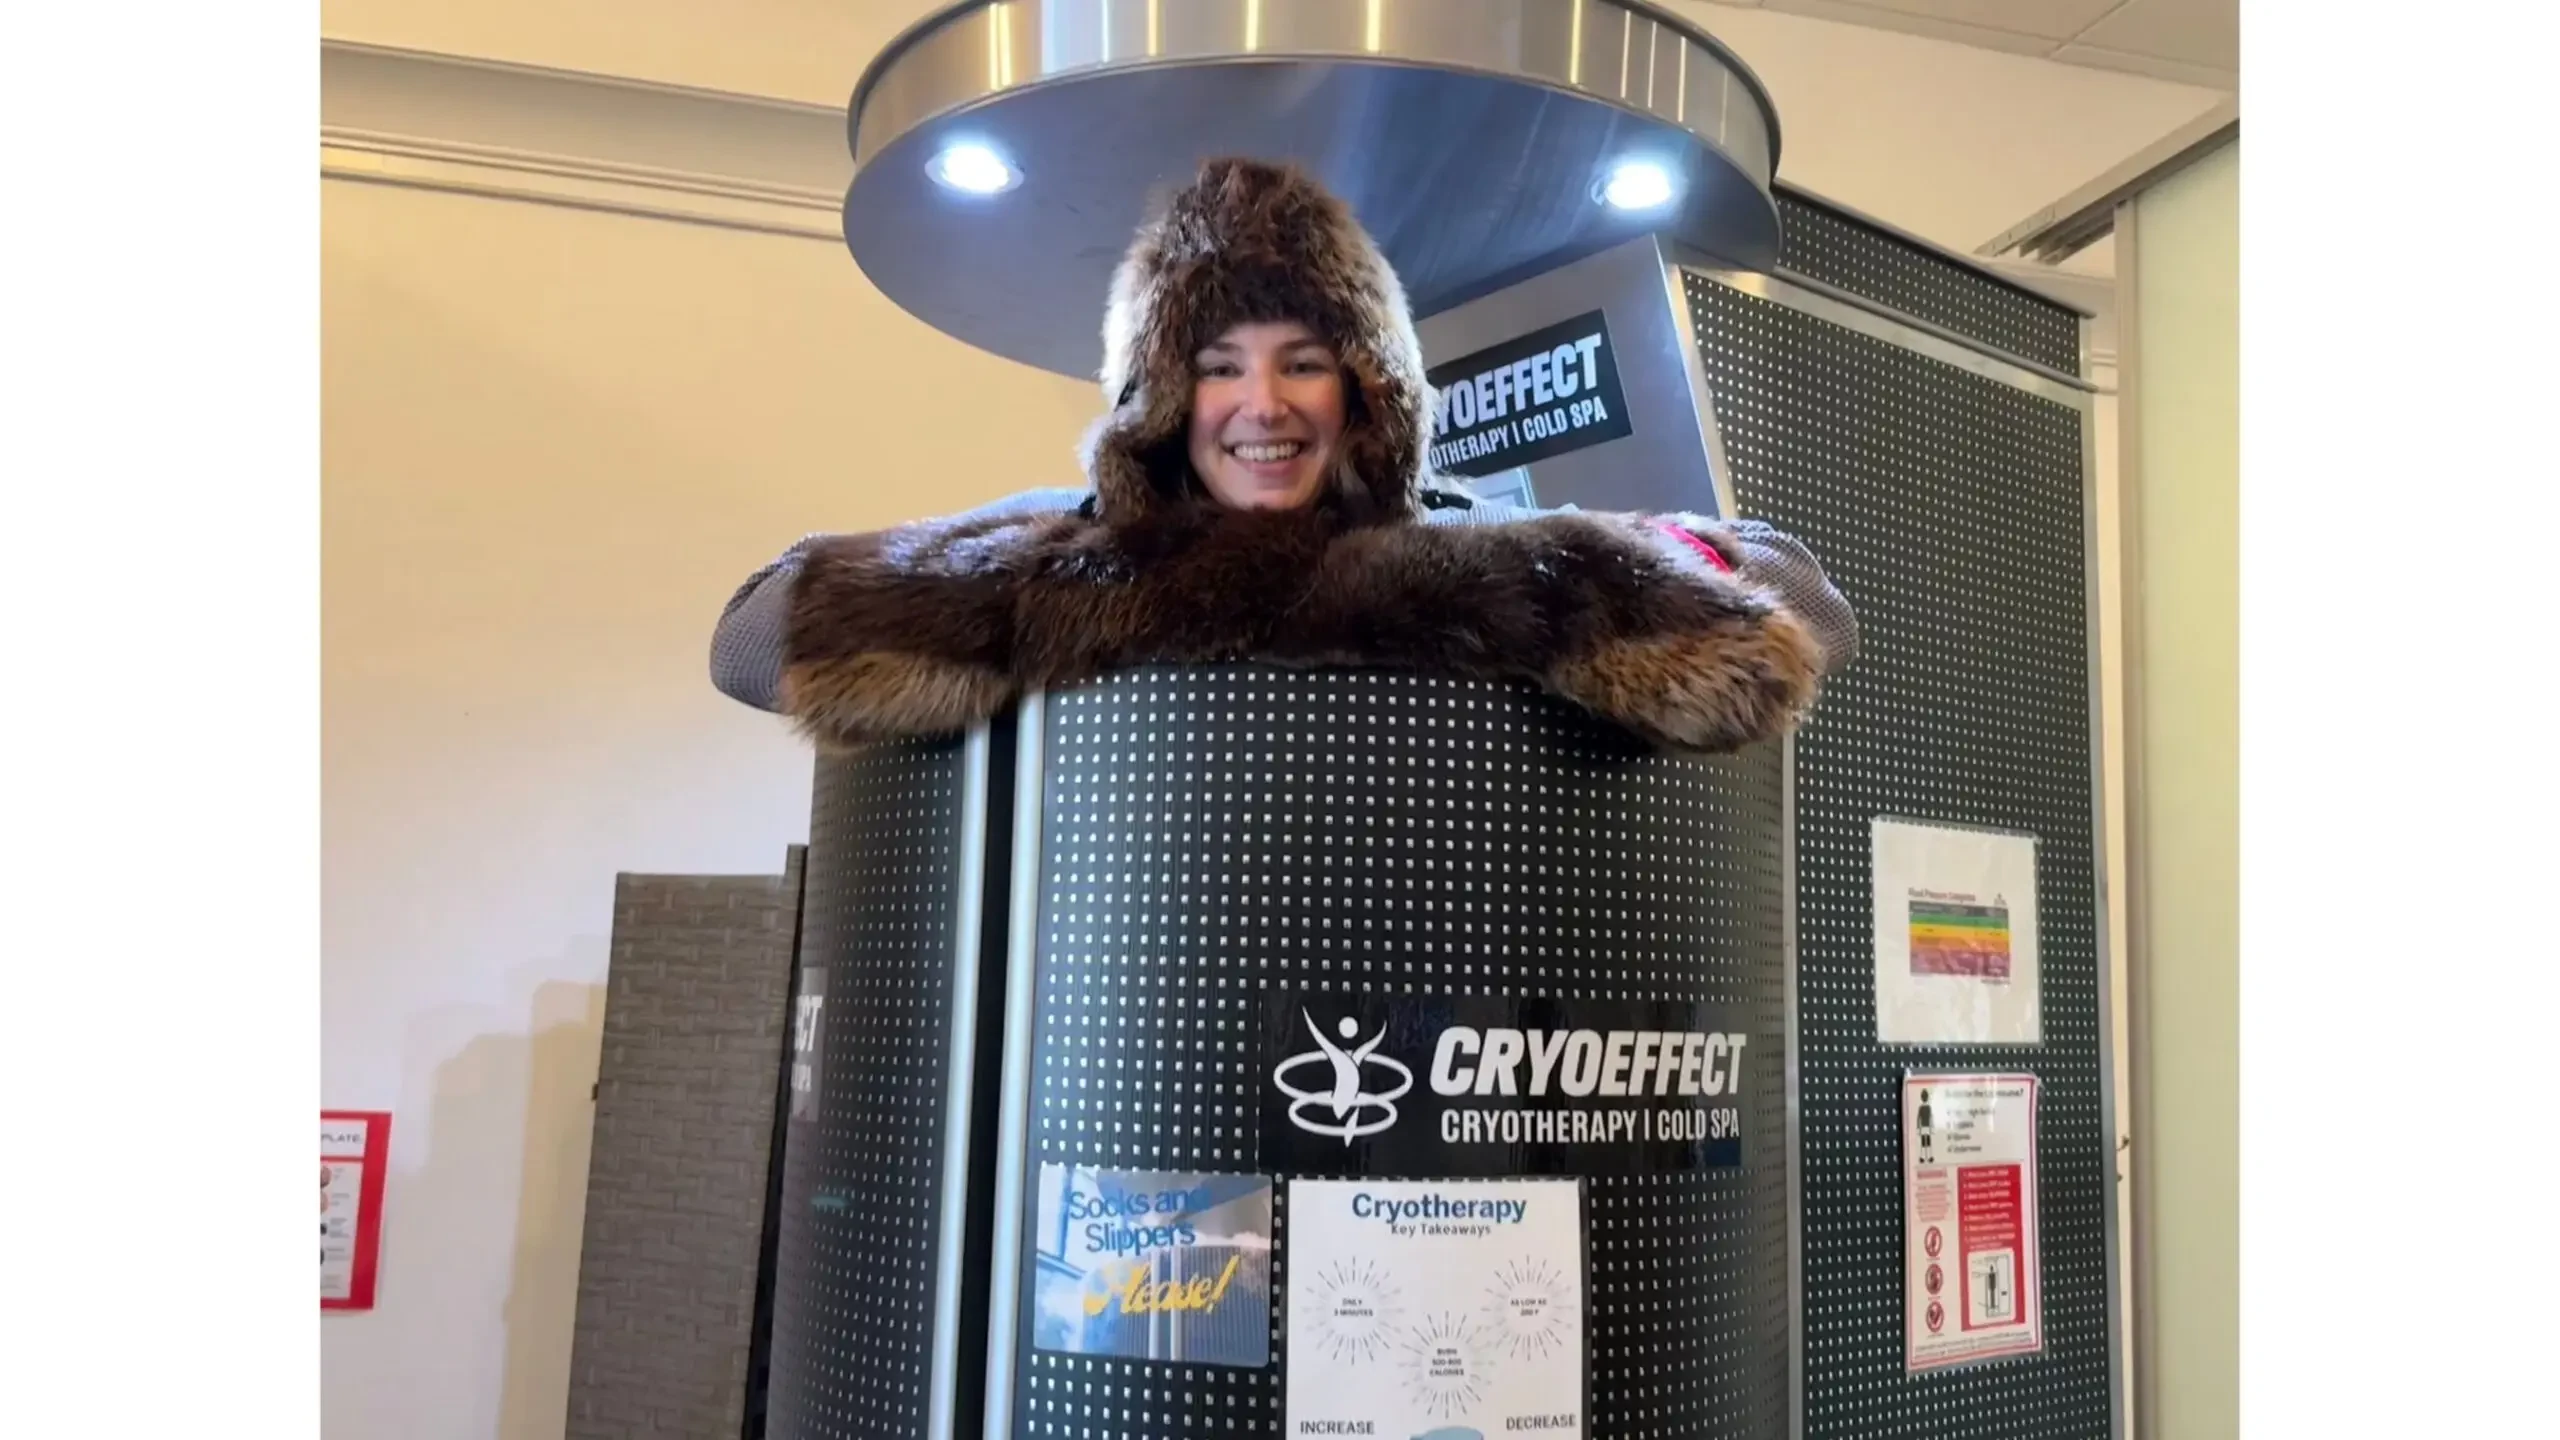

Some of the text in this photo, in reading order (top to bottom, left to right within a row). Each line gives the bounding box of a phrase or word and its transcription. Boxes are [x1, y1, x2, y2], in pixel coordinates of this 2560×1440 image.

[1437, 332, 1602, 436] YOEFFECT
[1429, 424, 1509, 470] OTHERAPY
[1522, 407, 1569, 442] COLD
[1569, 395, 1608, 429] SPA
[1429, 1026, 1747, 1097] CRYOEFFECT
[1441, 1109, 1637, 1144] CRYOTHERAPY
[1657, 1109, 1706, 1142] COLD
[1710, 1109, 1741, 1139] SPA
[1069, 1188, 1150, 1220] Socks
[1352, 1193, 1527, 1224] Cryotherapy
[1085, 1222, 1196, 1257] Slippers
[1391, 1223, 1491, 1239] Key Takeaways
[1083, 1254, 1240, 1316] Please!
[1300, 1420, 1375, 1435] INCREASE
[1505, 1414, 1577, 1431] DECREASE
